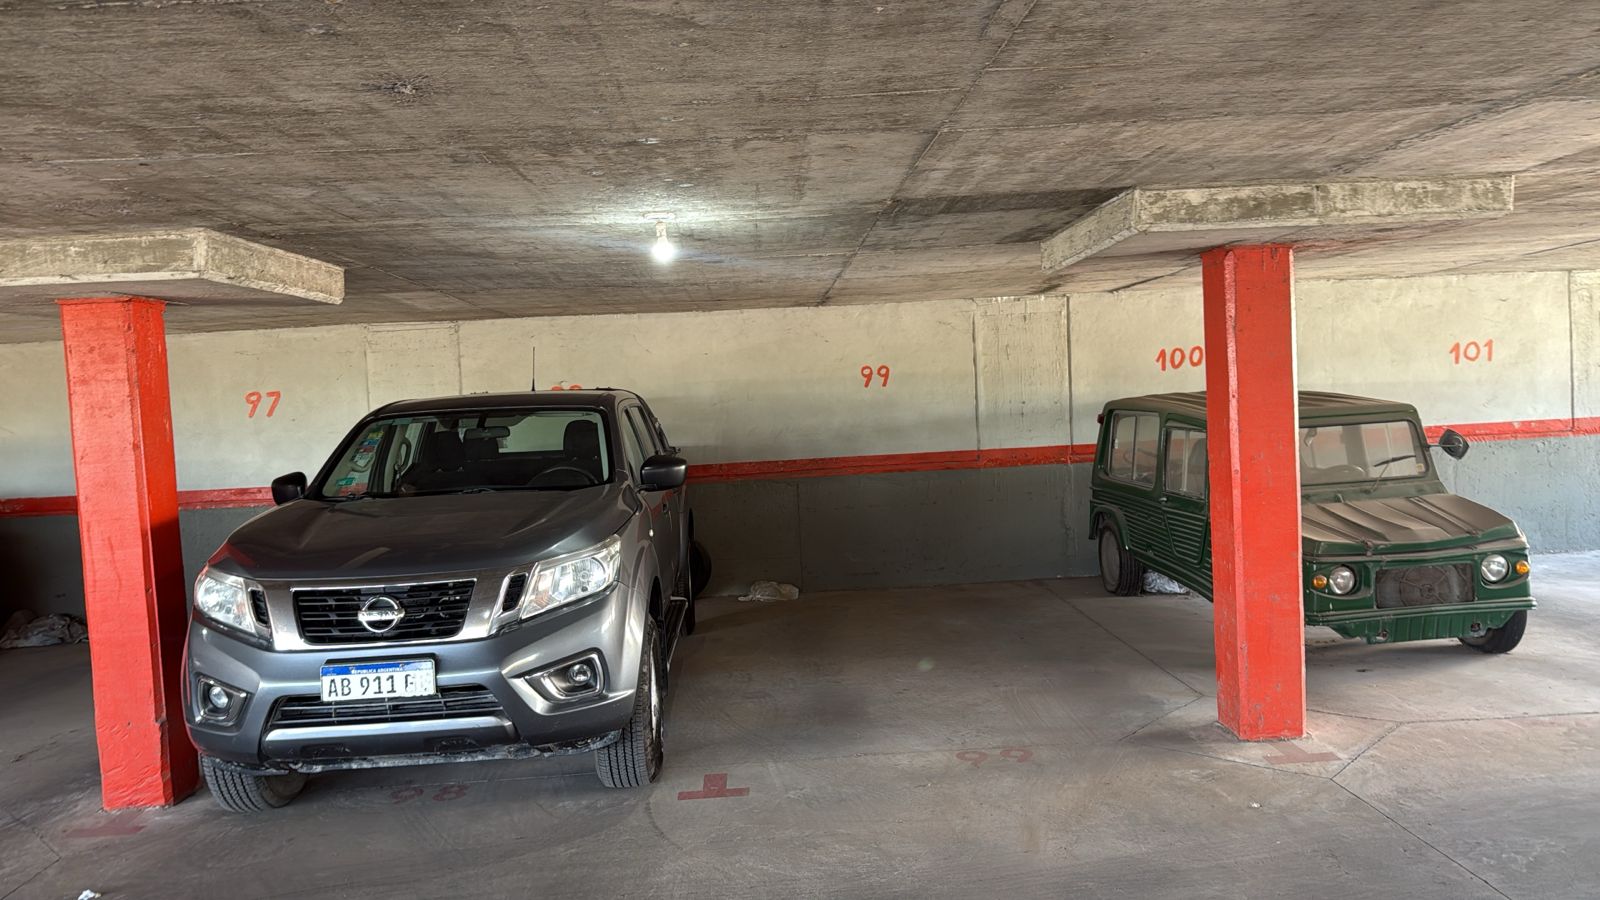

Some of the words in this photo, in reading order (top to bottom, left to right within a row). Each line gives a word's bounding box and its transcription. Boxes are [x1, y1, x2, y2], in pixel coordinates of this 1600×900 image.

[1156, 345, 1203, 371] 100
[1449, 339, 1493, 364] 101
[861, 364, 889, 388] 99
[245, 390, 281, 418] 97
[328, 677, 352, 697] AB
[360, 674, 397, 695] 911
